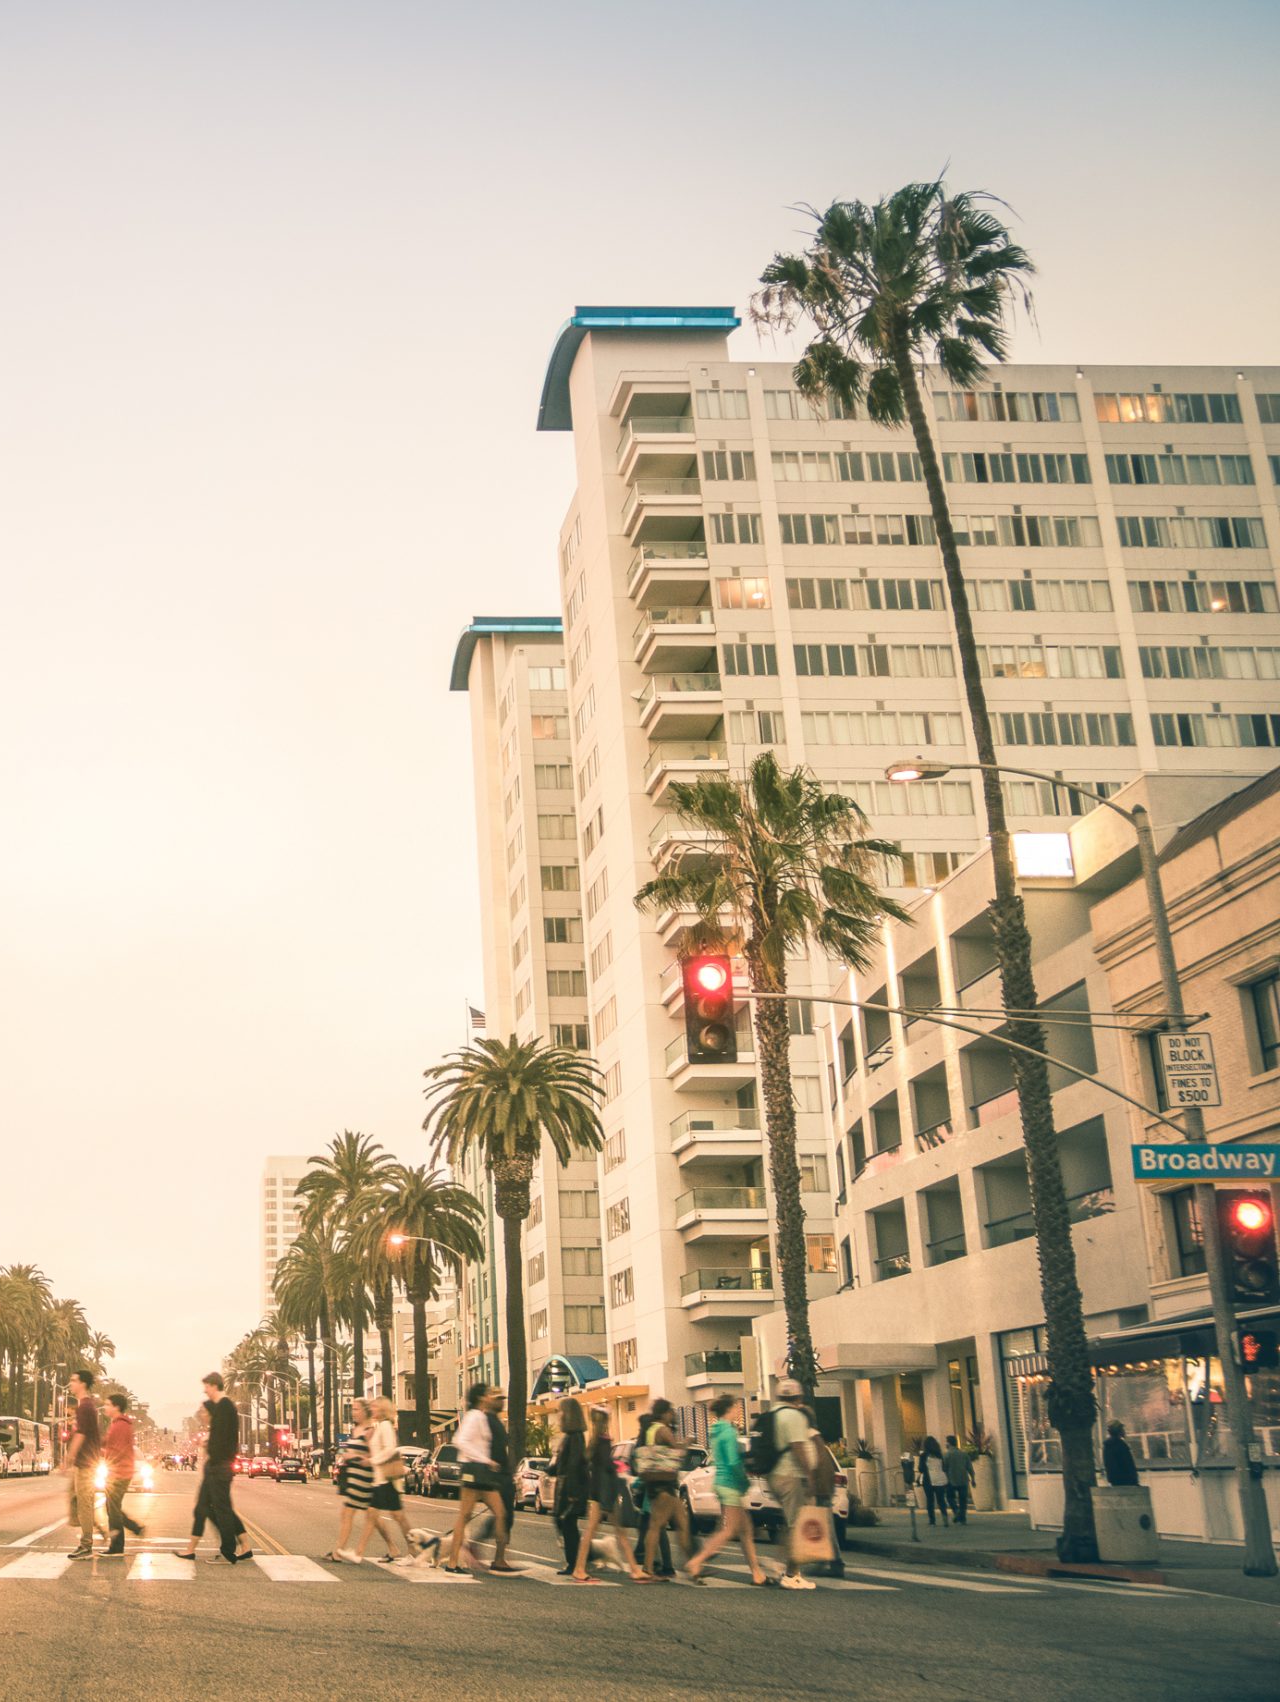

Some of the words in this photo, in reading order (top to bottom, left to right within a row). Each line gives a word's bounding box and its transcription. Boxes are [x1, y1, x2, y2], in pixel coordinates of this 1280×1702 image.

[1169, 1038, 1181, 1048] DO
[1185, 1037, 1201, 1047] NOT
[1170, 1050, 1205, 1062] BLOCK
[1166, 1063, 1213, 1072] INTERSECTION
[1171, 1078, 1197, 1088] FINES
[1201, 1077, 1212, 1088] TO
[1178, 1089, 1209, 1102] $500
[1140, 1147, 1276, 1175] Broadway
